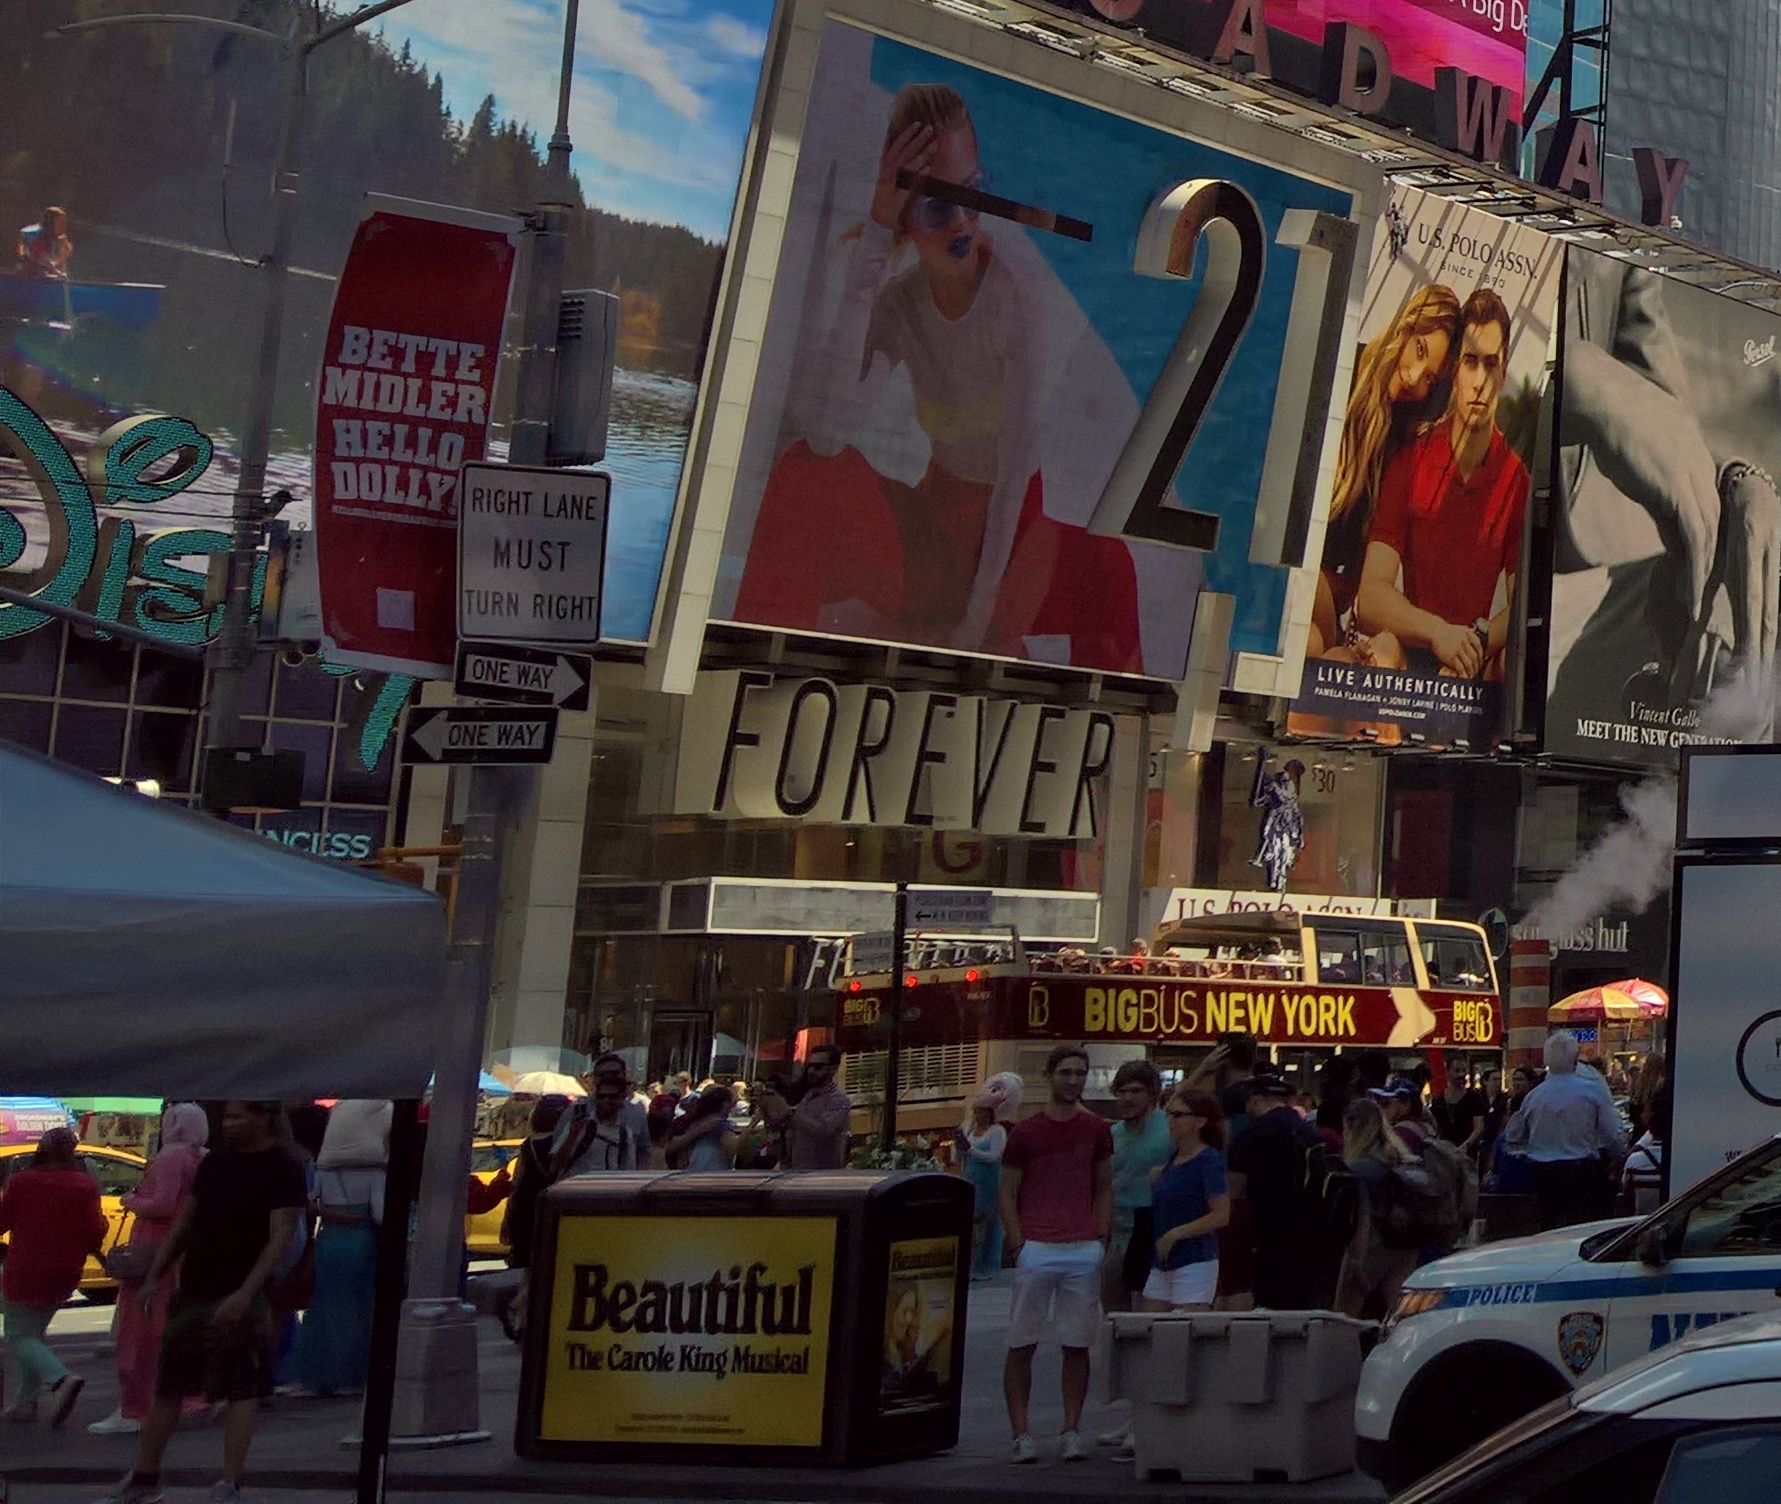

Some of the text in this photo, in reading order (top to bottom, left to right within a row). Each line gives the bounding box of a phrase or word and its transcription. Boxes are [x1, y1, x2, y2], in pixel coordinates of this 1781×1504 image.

[1418, 222, 1538, 280] U.S. POLO ASSN.
[1440, 260, 1474, 279] SINCE
[338, 324, 485, 382] BETTE
[1089, 176, 1360, 568] 21
[322, 366, 487, 425] MIDLER
[331, 418, 466, 471] HELLO
[471, 487, 533, 516] RIGHT
[543, 495, 598, 522] LANE
[494, 537, 572, 572] MUST
[465, 588, 597, 621] TURN RIGHT
[472, 659, 554, 690] ONE WAY
[1317, 666, 1484, 701] LIVE AUTHENTICALLY
[1630, 700, 1671, 724] Vincent
[449, 723, 541, 748] ONE WAY
[1576, 718, 1670, 747] MEET THE NEW
[695, 668, 1117, 840] FOREVER
[1312, 767, 1336, 794] $30
[1599, 916, 1629, 952] hut
[1205, 991, 1275, 1035] NEW
[1280, 994, 1357, 1037] YORK
[1453, 999, 1476, 1022] BIG
[1453, 1022, 1476, 1043] BUS
[566, 1259, 817, 1336] Beautiful
[1467, 1283, 1536, 1307] POLICE
[566, 1342, 810, 1380] The Carole King Musical
